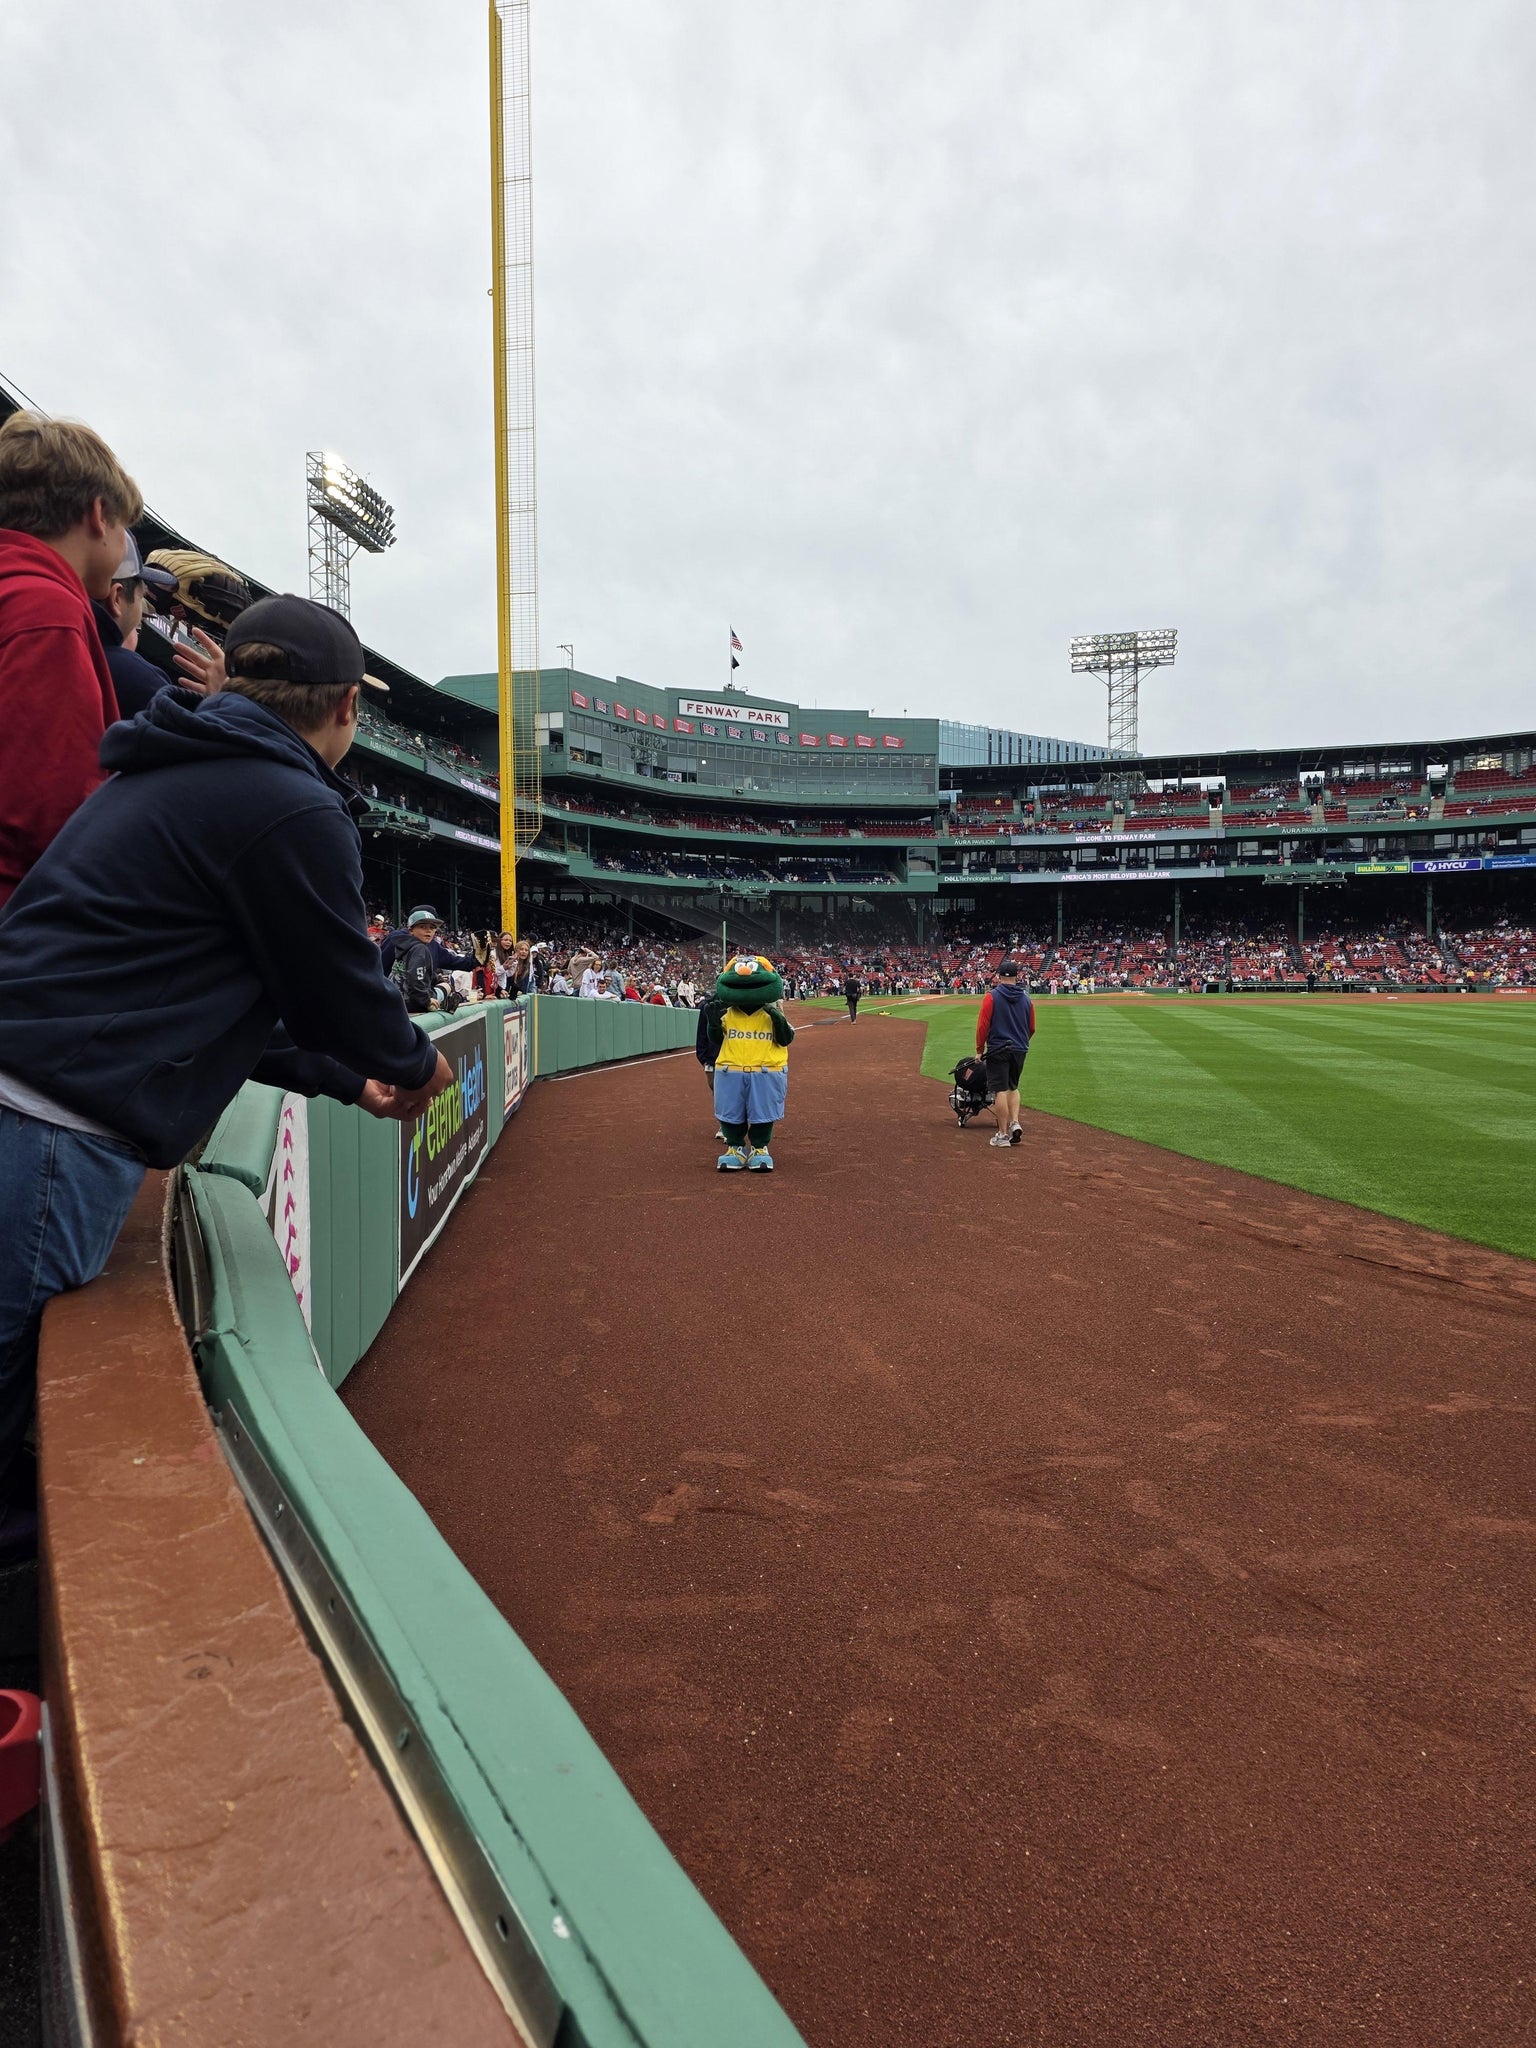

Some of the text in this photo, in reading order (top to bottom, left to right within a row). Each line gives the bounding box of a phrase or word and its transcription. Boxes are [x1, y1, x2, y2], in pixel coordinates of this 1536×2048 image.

[687, 703, 781, 724] FENWAY PARK
[728, 1029, 773, 1040] Boston
[428, 1182, 438, 1207] Your
